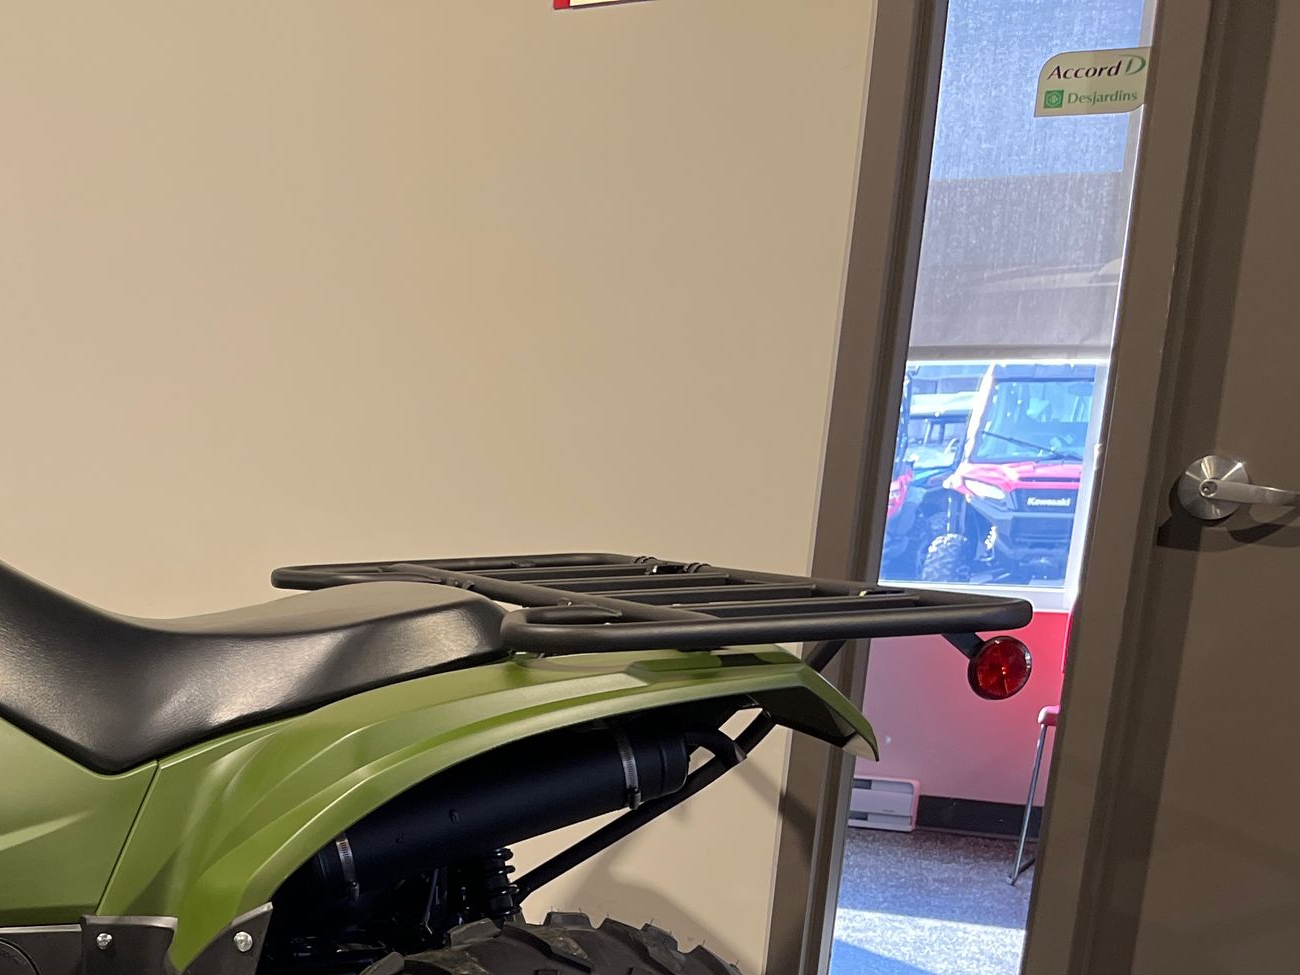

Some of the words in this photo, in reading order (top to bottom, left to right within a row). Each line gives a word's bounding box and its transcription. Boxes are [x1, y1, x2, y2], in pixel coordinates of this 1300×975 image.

[1047, 60, 1122, 80] Accord
[1068, 90, 1138, 105] Desjardins
[1026, 497, 1071, 507] Kawasaki
